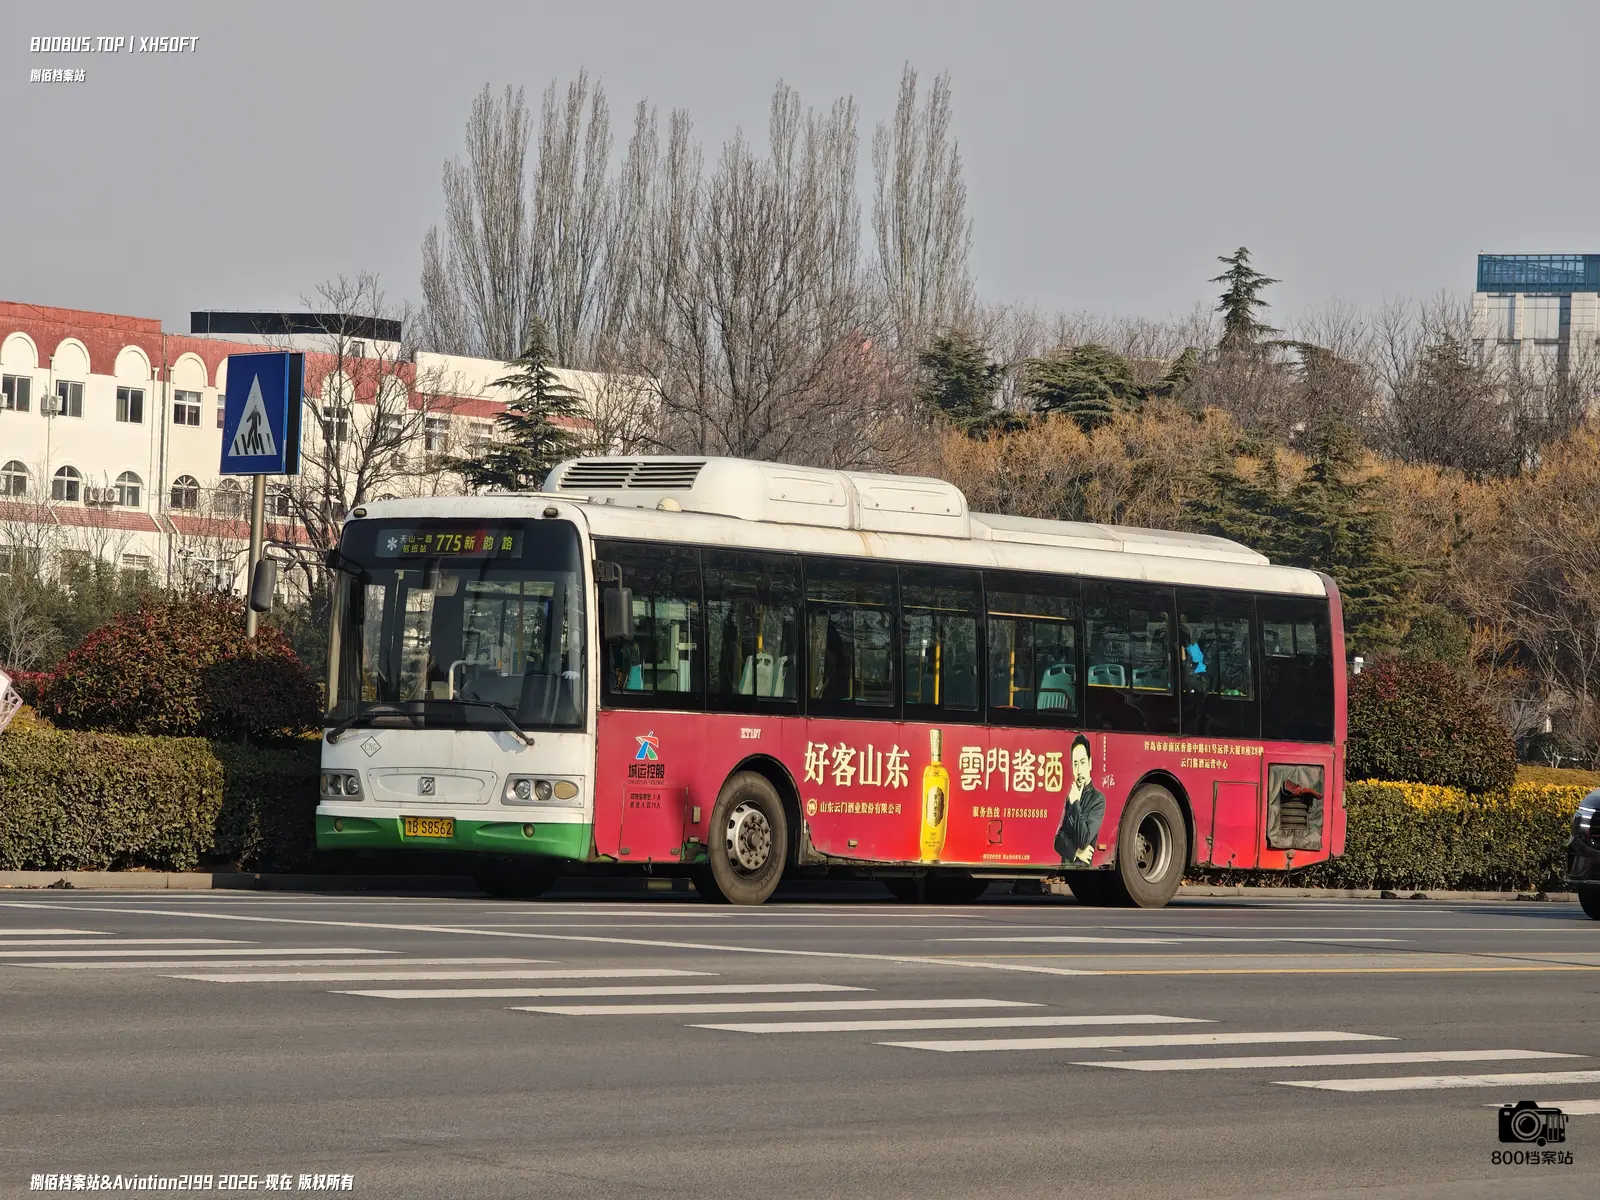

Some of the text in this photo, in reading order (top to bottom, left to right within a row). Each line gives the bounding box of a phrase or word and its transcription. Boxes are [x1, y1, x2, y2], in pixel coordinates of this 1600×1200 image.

[436, 534, 462, 552] 775
[628, 763, 665, 779] 城运控股
[803, 740, 911, 789] 好客山东
[819, 800, 902, 815] 山东云门酒业股份有限公司
[972, 806, 1048, 819] 服务热线 18763636988
